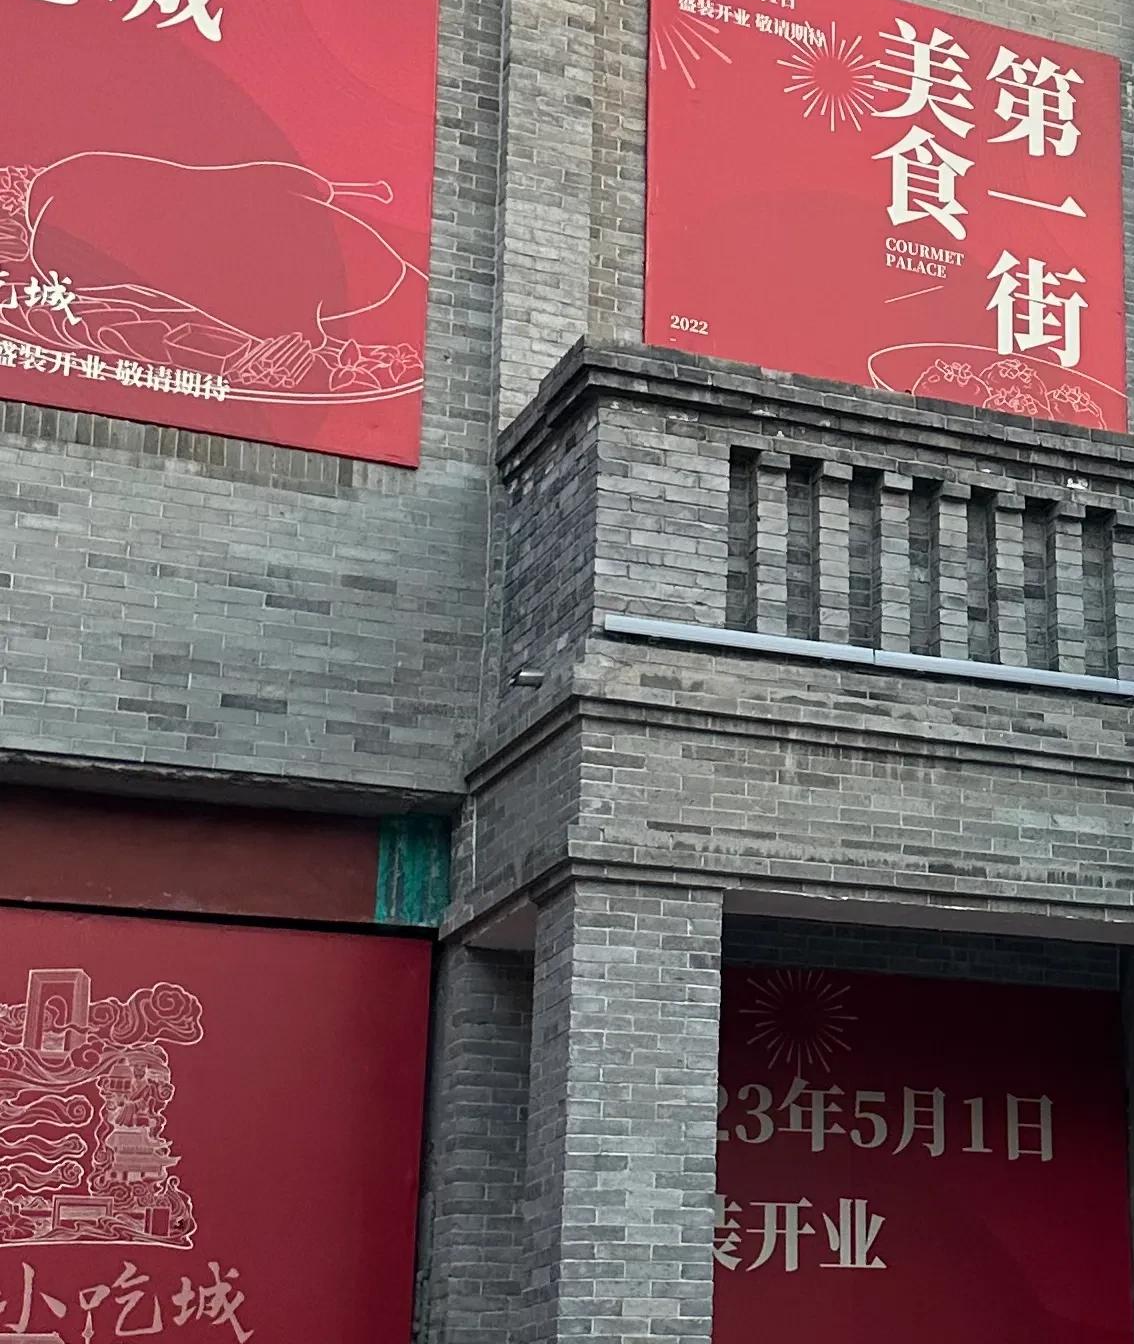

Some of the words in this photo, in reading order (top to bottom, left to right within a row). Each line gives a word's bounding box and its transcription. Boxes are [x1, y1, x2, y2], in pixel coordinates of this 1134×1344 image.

[871, 18, 976, 241] 美食
[986, 44, 1088, 368] 第一街
[885, 237, 965, 267] COURMET
[885, 253, 947, 279] PALACE
[670, 315, 709, 336] 2022
[115, 358, 234, 402] 敬请期待
